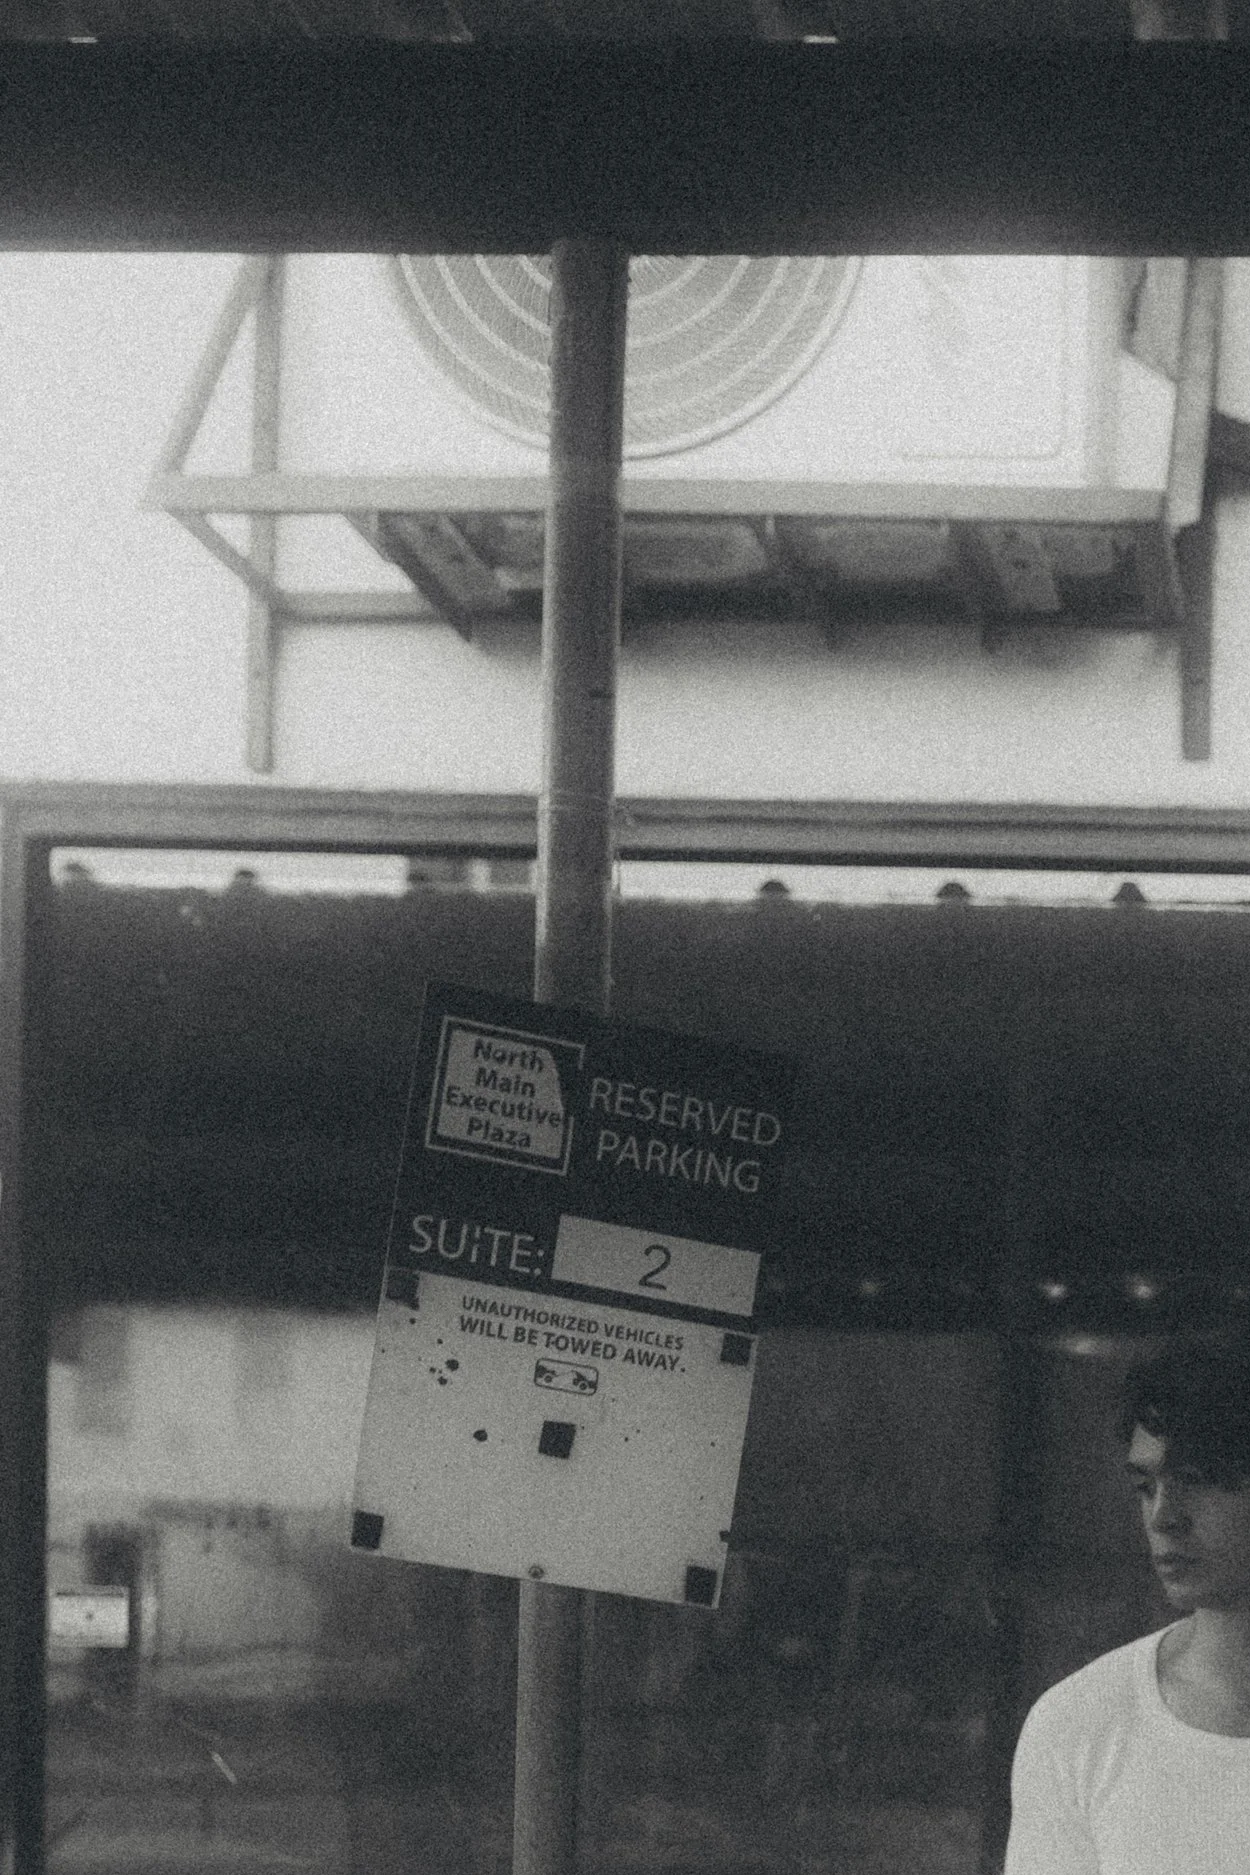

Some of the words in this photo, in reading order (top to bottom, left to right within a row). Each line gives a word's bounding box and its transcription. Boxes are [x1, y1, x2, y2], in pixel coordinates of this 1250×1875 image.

[473, 1038, 545, 1073] North
[475, 1067, 536, 1098] Main
[446, 1085, 562, 1128] Executive
[467, 1116, 531, 1148] Plaza
[590, 1077, 781, 1145] RESERVED
[597, 1129, 760, 1192] PARKING
[409, 1214, 545, 1276] SUITE:
[637, 1243, 673, 1291] 2
[459, 1314, 508, 1341] WILL
[513, 1326, 538, 1347] BE
[543, 1330, 617, 1361] TOWED
[623, 1348, 687, 1373] AWAY.
[461, 1295, 599, 1335] UNAUTHORIZED
[604, 1322, 685, 1352] VEHICLES
